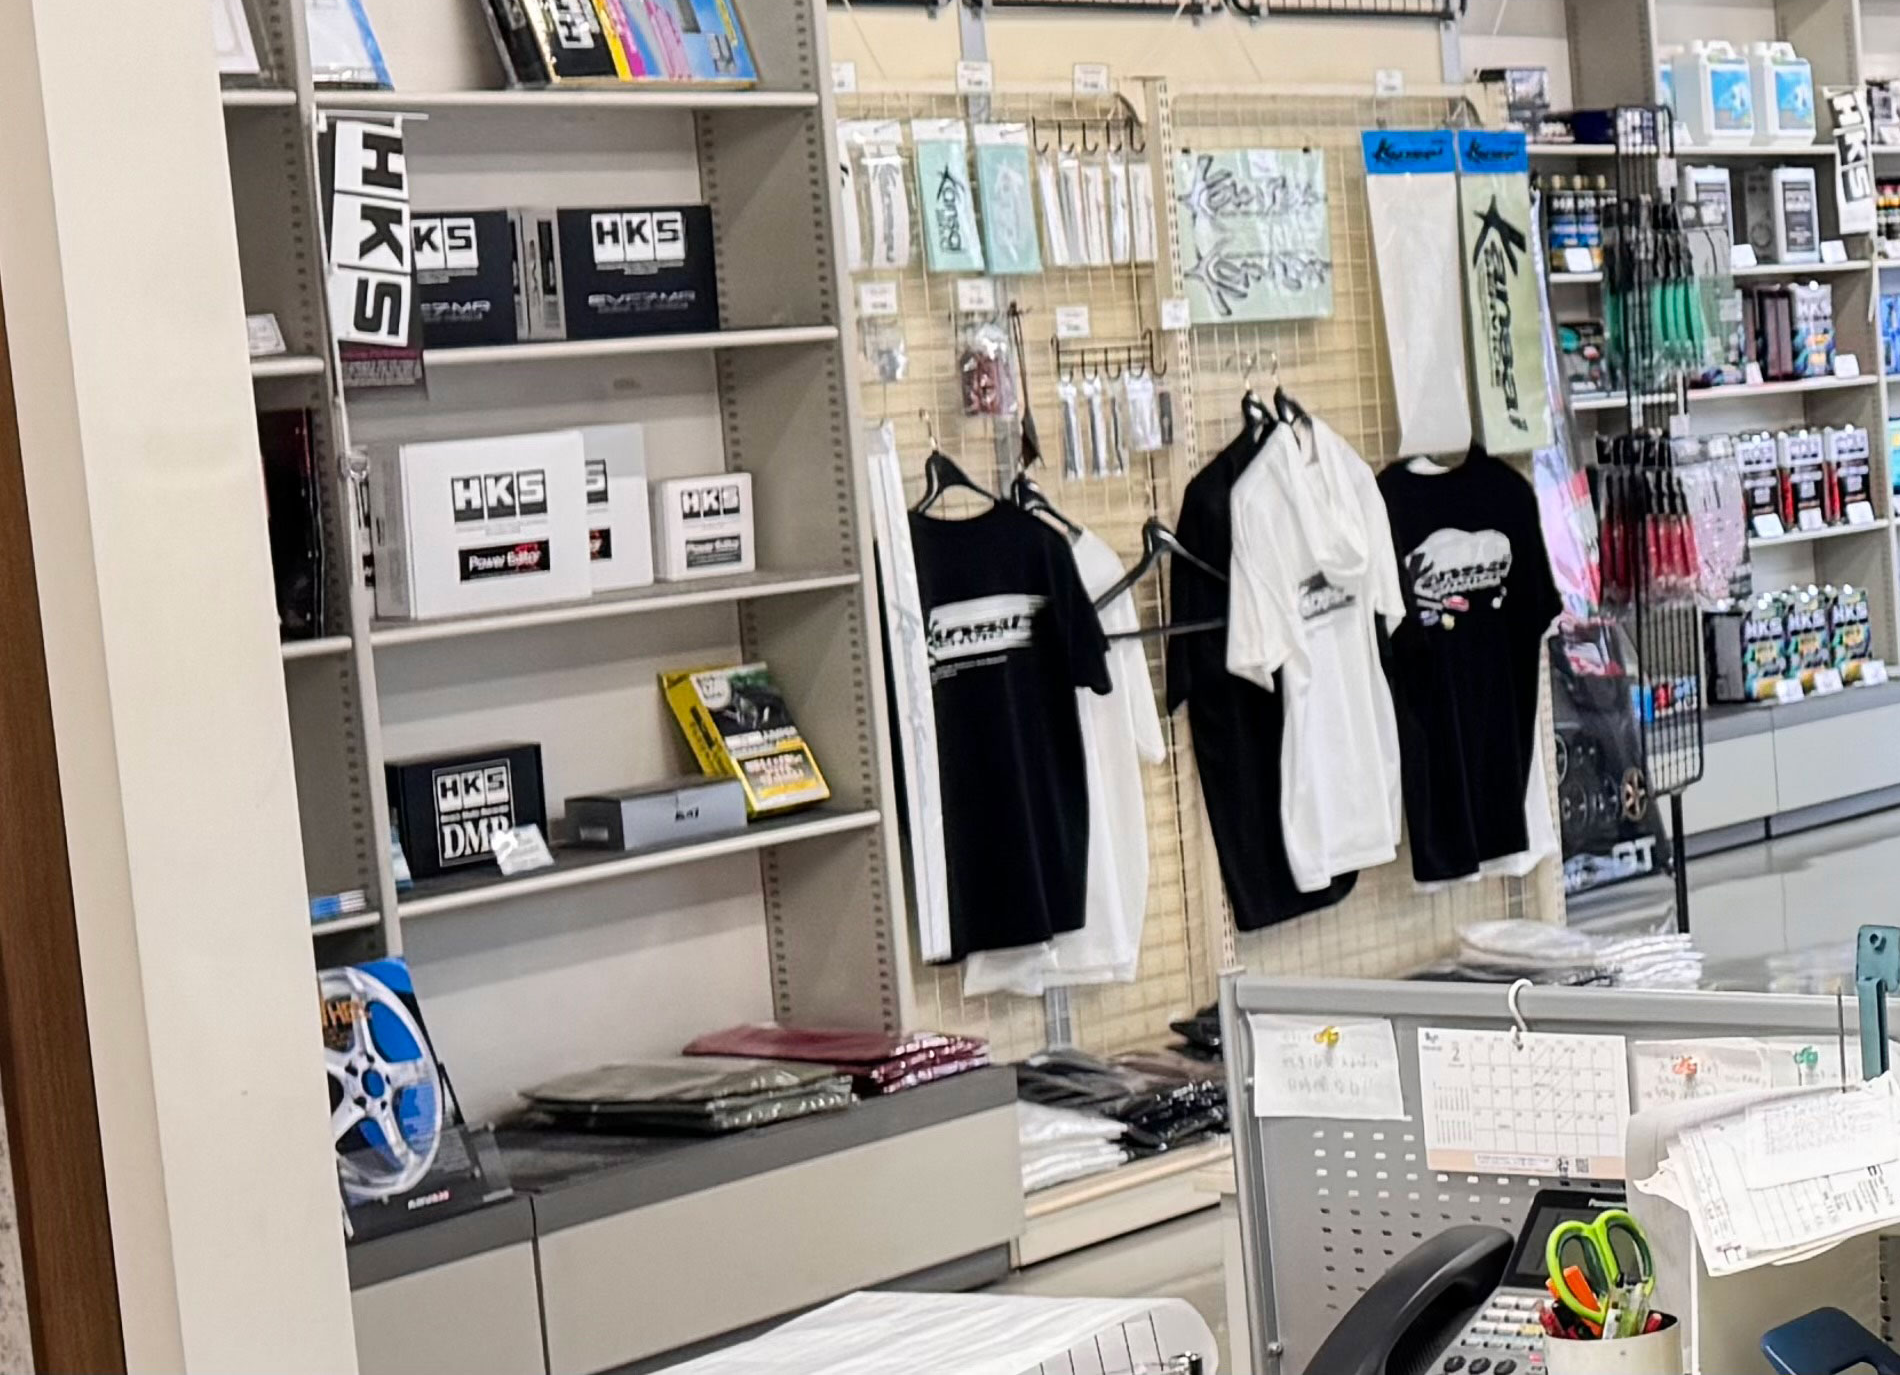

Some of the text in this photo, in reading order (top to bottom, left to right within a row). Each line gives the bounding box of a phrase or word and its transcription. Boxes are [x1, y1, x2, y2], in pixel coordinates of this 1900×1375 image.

[1832, 93, 1871, 200] HKS
[353, 131, 405, 337] HKS
[596, 217, 683, 247] HKS
[453, 474, 546, 512] HKS
[683, 486, 740, 515] HKS
[440, 771, 508, 804] HKS
